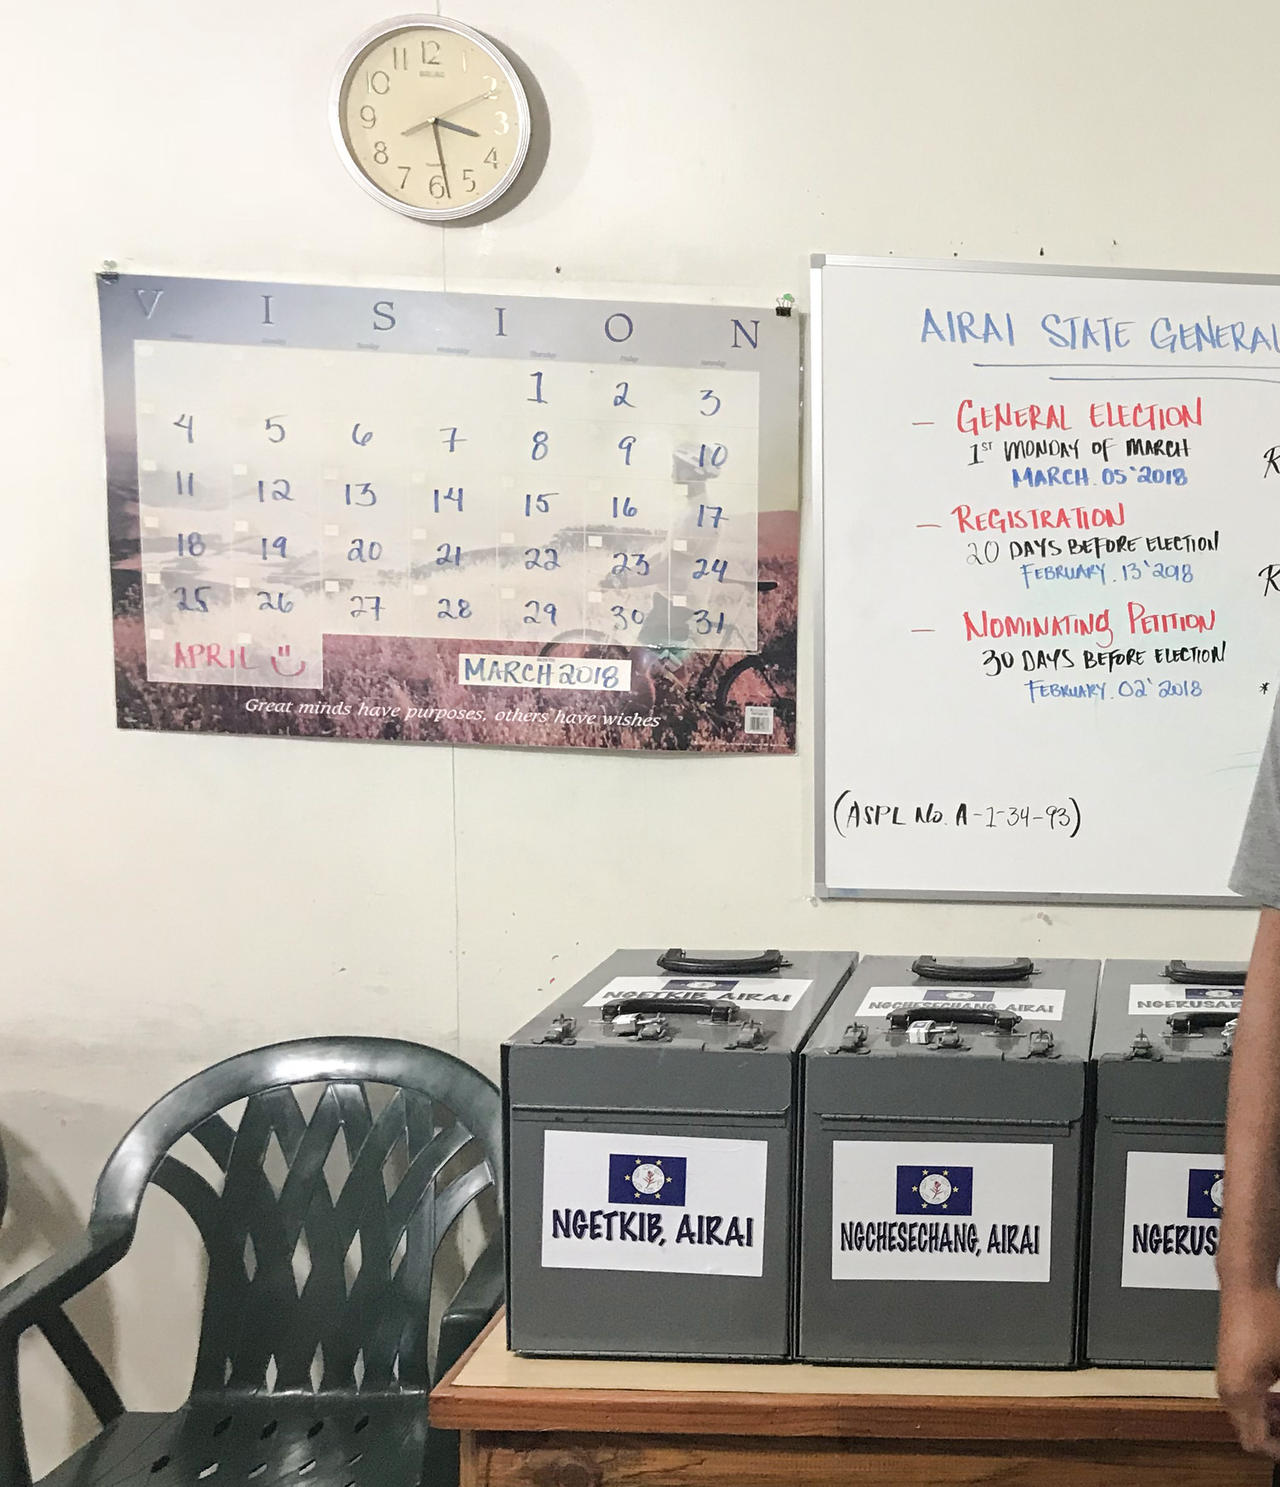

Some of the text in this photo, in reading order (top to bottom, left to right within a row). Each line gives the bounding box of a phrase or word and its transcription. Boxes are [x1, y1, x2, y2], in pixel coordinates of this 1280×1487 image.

[393, 47, 407, 71] 11
[421, 41, 440, 65] 12
[366, 70, 390, 95] 10
[360, 105, 376, 129] 9
[494, 111, 509, 136] 3
[374, 141, 389, 165] 8
[484, 147, 498, 170] 4
[398, 166, 411, 189] 7
[429, 175, 446, 199] 6
[463, 169, 476, 193] 5
[920, 308, 1015, 346] AIRAI
[1041, 313, 1136, 352] STATE
[527, 371, 721, 416] 1 2 3
[956, 396, 1202, 436] GENERAL ELECTION
[173, 413, 728, 467] 4 5 6 7 8 9 10
[1003, 438, 1079, 462] MONDAY
[1091, 438, 1115, 461] OF
[1126, 438, 1192, 458] MARCH
[176, 471, 728, 528] 11 12 13 14 15 16 17
[951, 502, 1126, 534] REGISTRATION
[178, 532, 728, 583] 18 19 20 21 22 23 24
[966, 530, 1220, 566] 20 DAYS BEFORE ELECTION
[174, 586, 724, 635] 25 26 27 28 29 30 31
[1127, 601, 1216, 635] PETITION
[174, 642, 257, 670] APRIL
[982, 640, 1227, 677] 30 DAYS BEFORE ELECTION
[464, 657, 619, 688] MARCH 2018
[245, 698, 661, 728] Great minds have purposes, others have wishes
[833, 790, 907, 838] (ASPL
[551, 1208, 754, 1248] NGETKIB, AIRAI
[840, 1221, 1040, 1257] NGCHESECHANG, AIRAI
[1132, 1223, 1219, 1255] NGERUS
